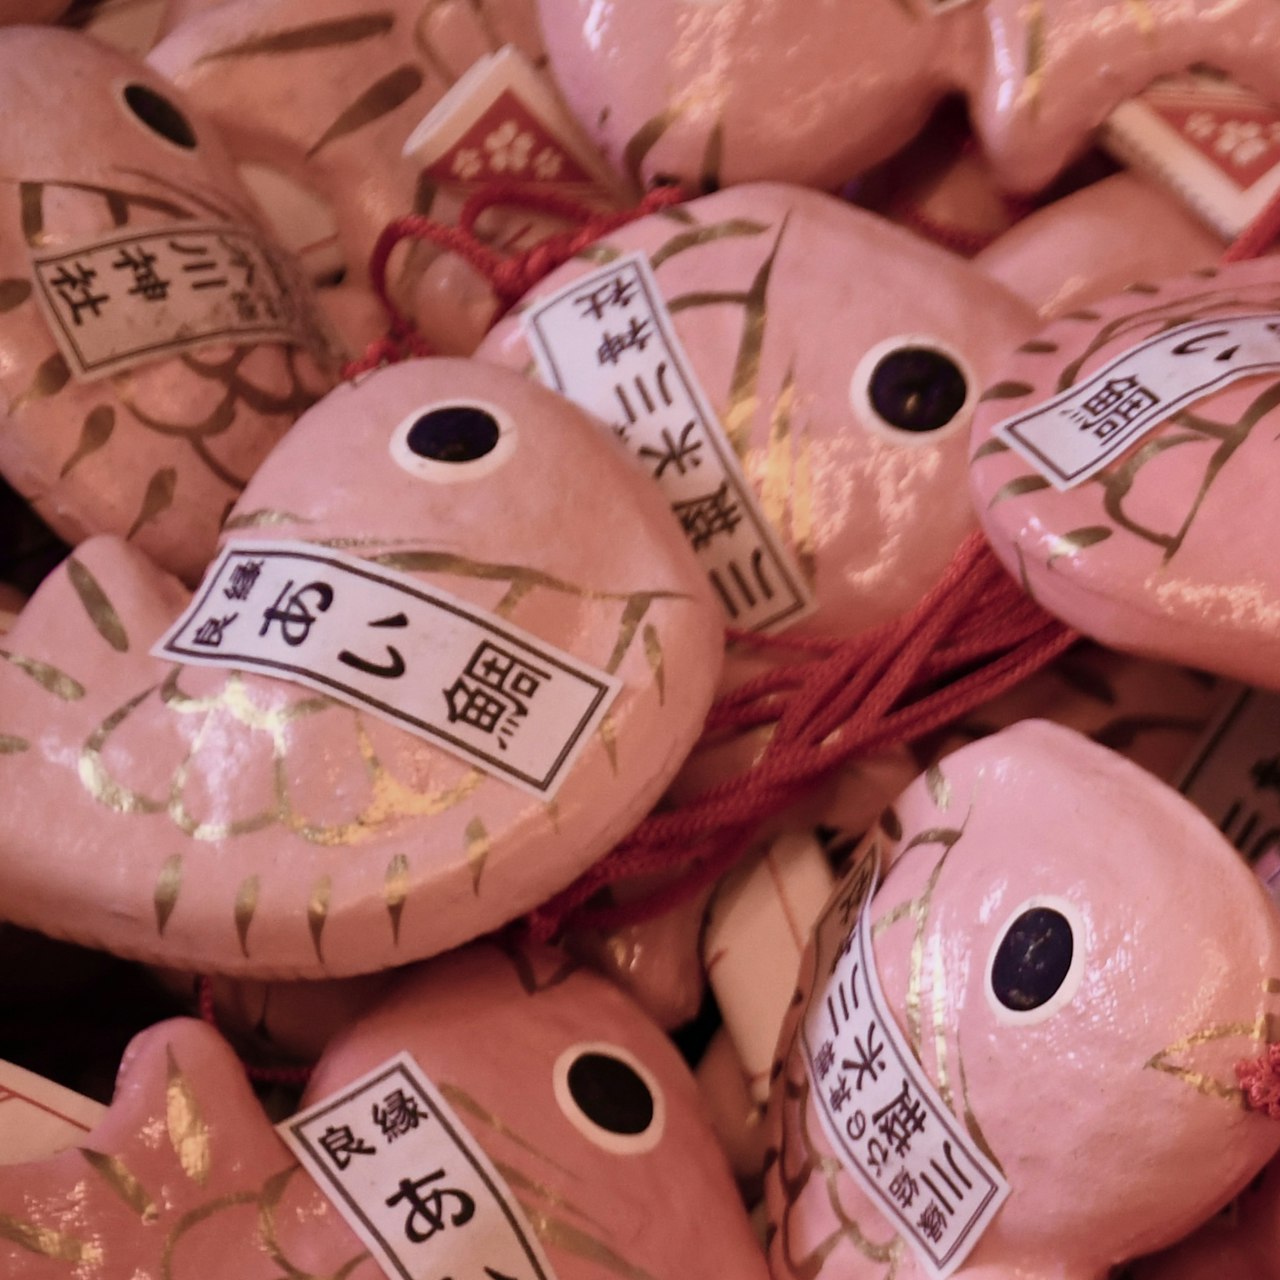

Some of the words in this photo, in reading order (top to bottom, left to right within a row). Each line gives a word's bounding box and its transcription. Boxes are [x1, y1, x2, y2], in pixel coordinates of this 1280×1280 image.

[193, 558, 266, 648] 良縁
[258, 579, 552, 750] あい鯛
[318, 1090, 428, 1170] 良縁
